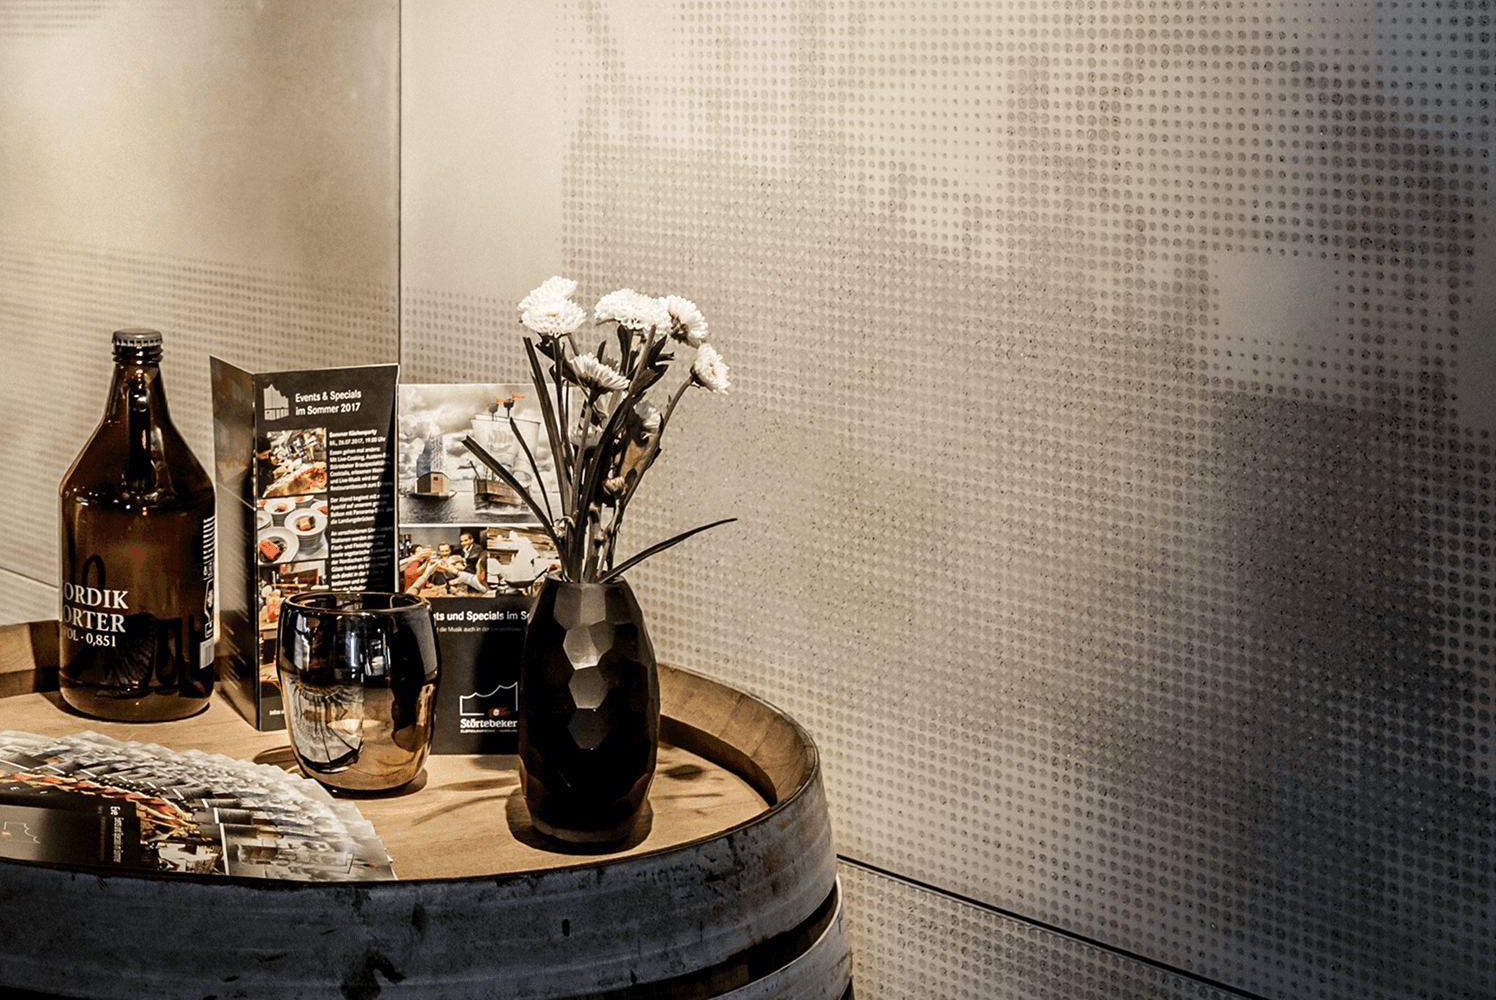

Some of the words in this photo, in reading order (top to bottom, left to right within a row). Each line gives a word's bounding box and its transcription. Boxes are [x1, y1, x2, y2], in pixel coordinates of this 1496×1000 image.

[295, 393, 321, 402] Events
[322, 391, 328, 401] &
[330, 389, 362, 402] Specials
[295, 406, 305, 415] im
[307, 405, 339, 415] Sommer
[340, 402, 361, 413] 2017
[447, 611, 464, 620] und
[466, 610, 504, 622] Specials
[507, 611, 518, 620] im
[460, 718, 518, 729] Störtebeker
